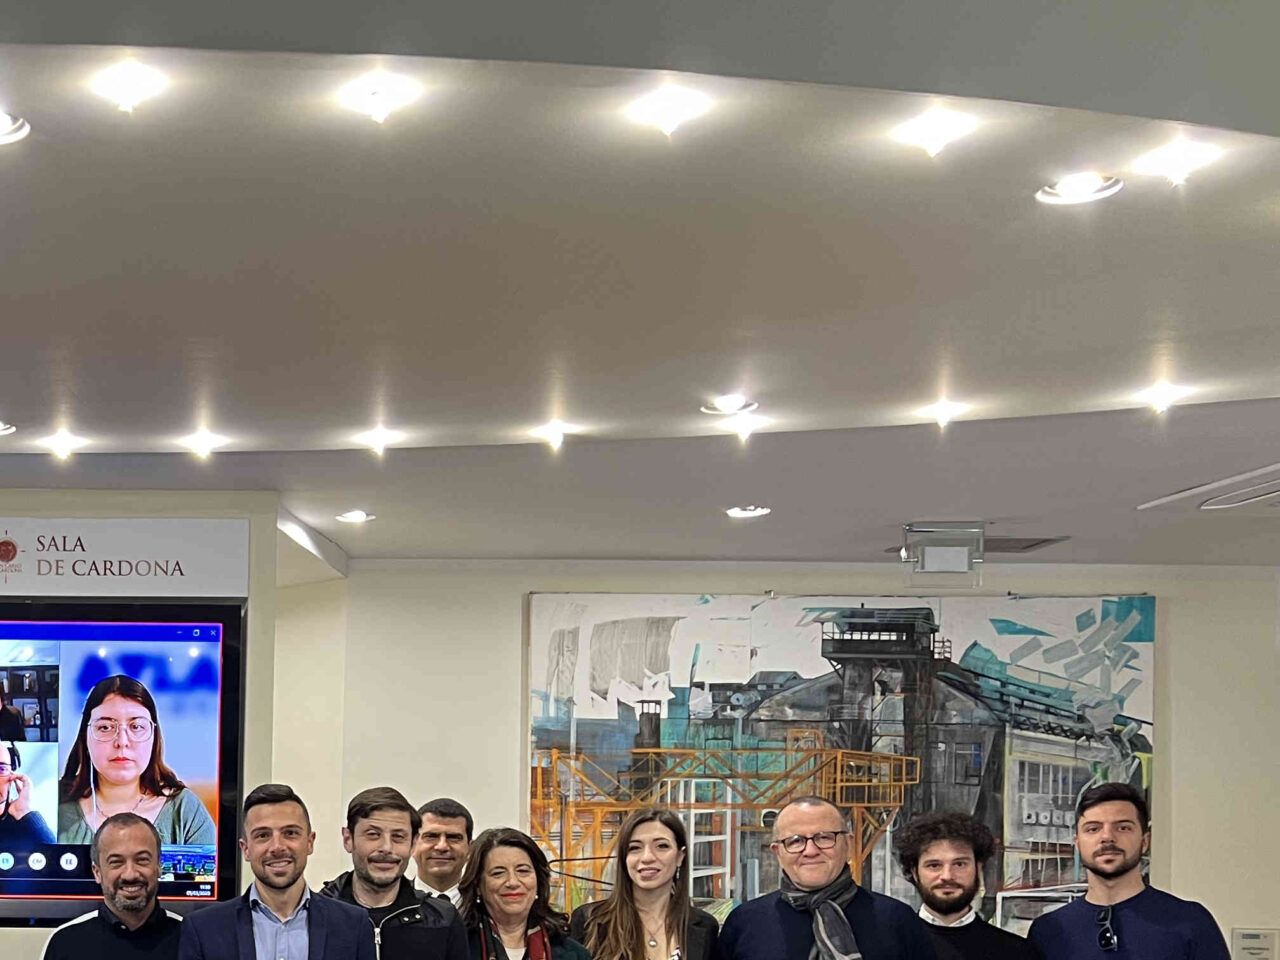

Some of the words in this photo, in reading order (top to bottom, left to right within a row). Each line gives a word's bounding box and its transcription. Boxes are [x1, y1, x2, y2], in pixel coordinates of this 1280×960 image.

[36, 535, 86, 552] SALA
[37, 559, 65, 576] DE
[71, 559, 185, 576] CARDONA
